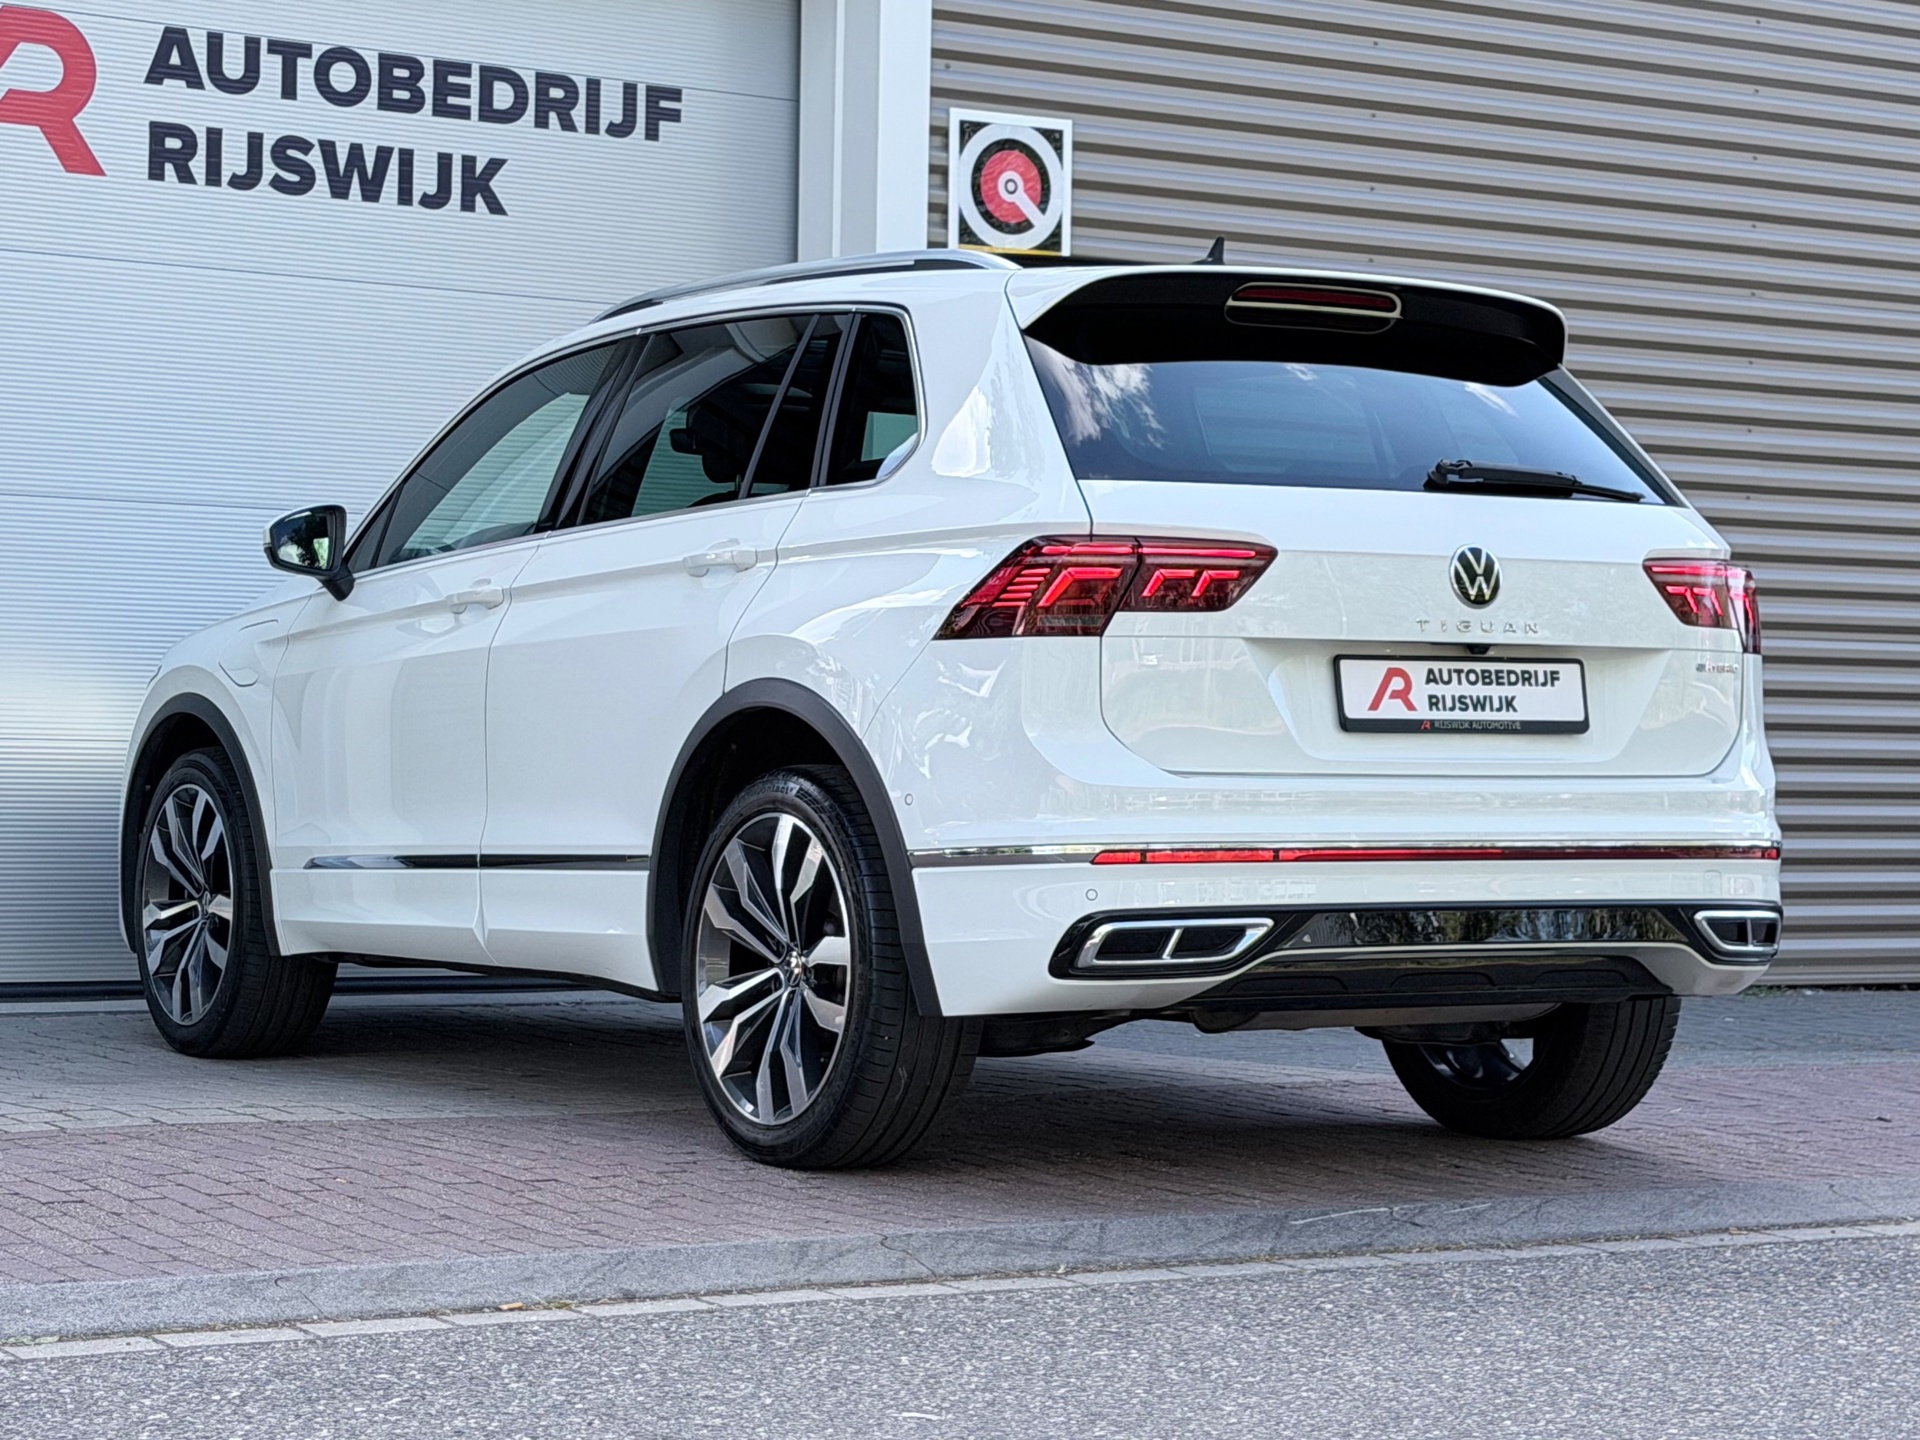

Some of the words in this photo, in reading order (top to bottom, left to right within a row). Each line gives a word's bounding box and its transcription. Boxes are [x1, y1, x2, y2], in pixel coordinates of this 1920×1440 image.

[144, 26, 683, 141] AUTOBEDRIJF
[147, 120, 509, 216] RIJSWIJK
[1416, 619, 1539, 634] TIGUAN
[1425, 668, 1560, 687] AUTOBEDRIJF
[1428, 694, 1518, 712] RIJSWIJK
[1434, 720, 1470, 729] RIJSWIJK
[1472, 721, 1521, 730] AUTOMOTIVE
